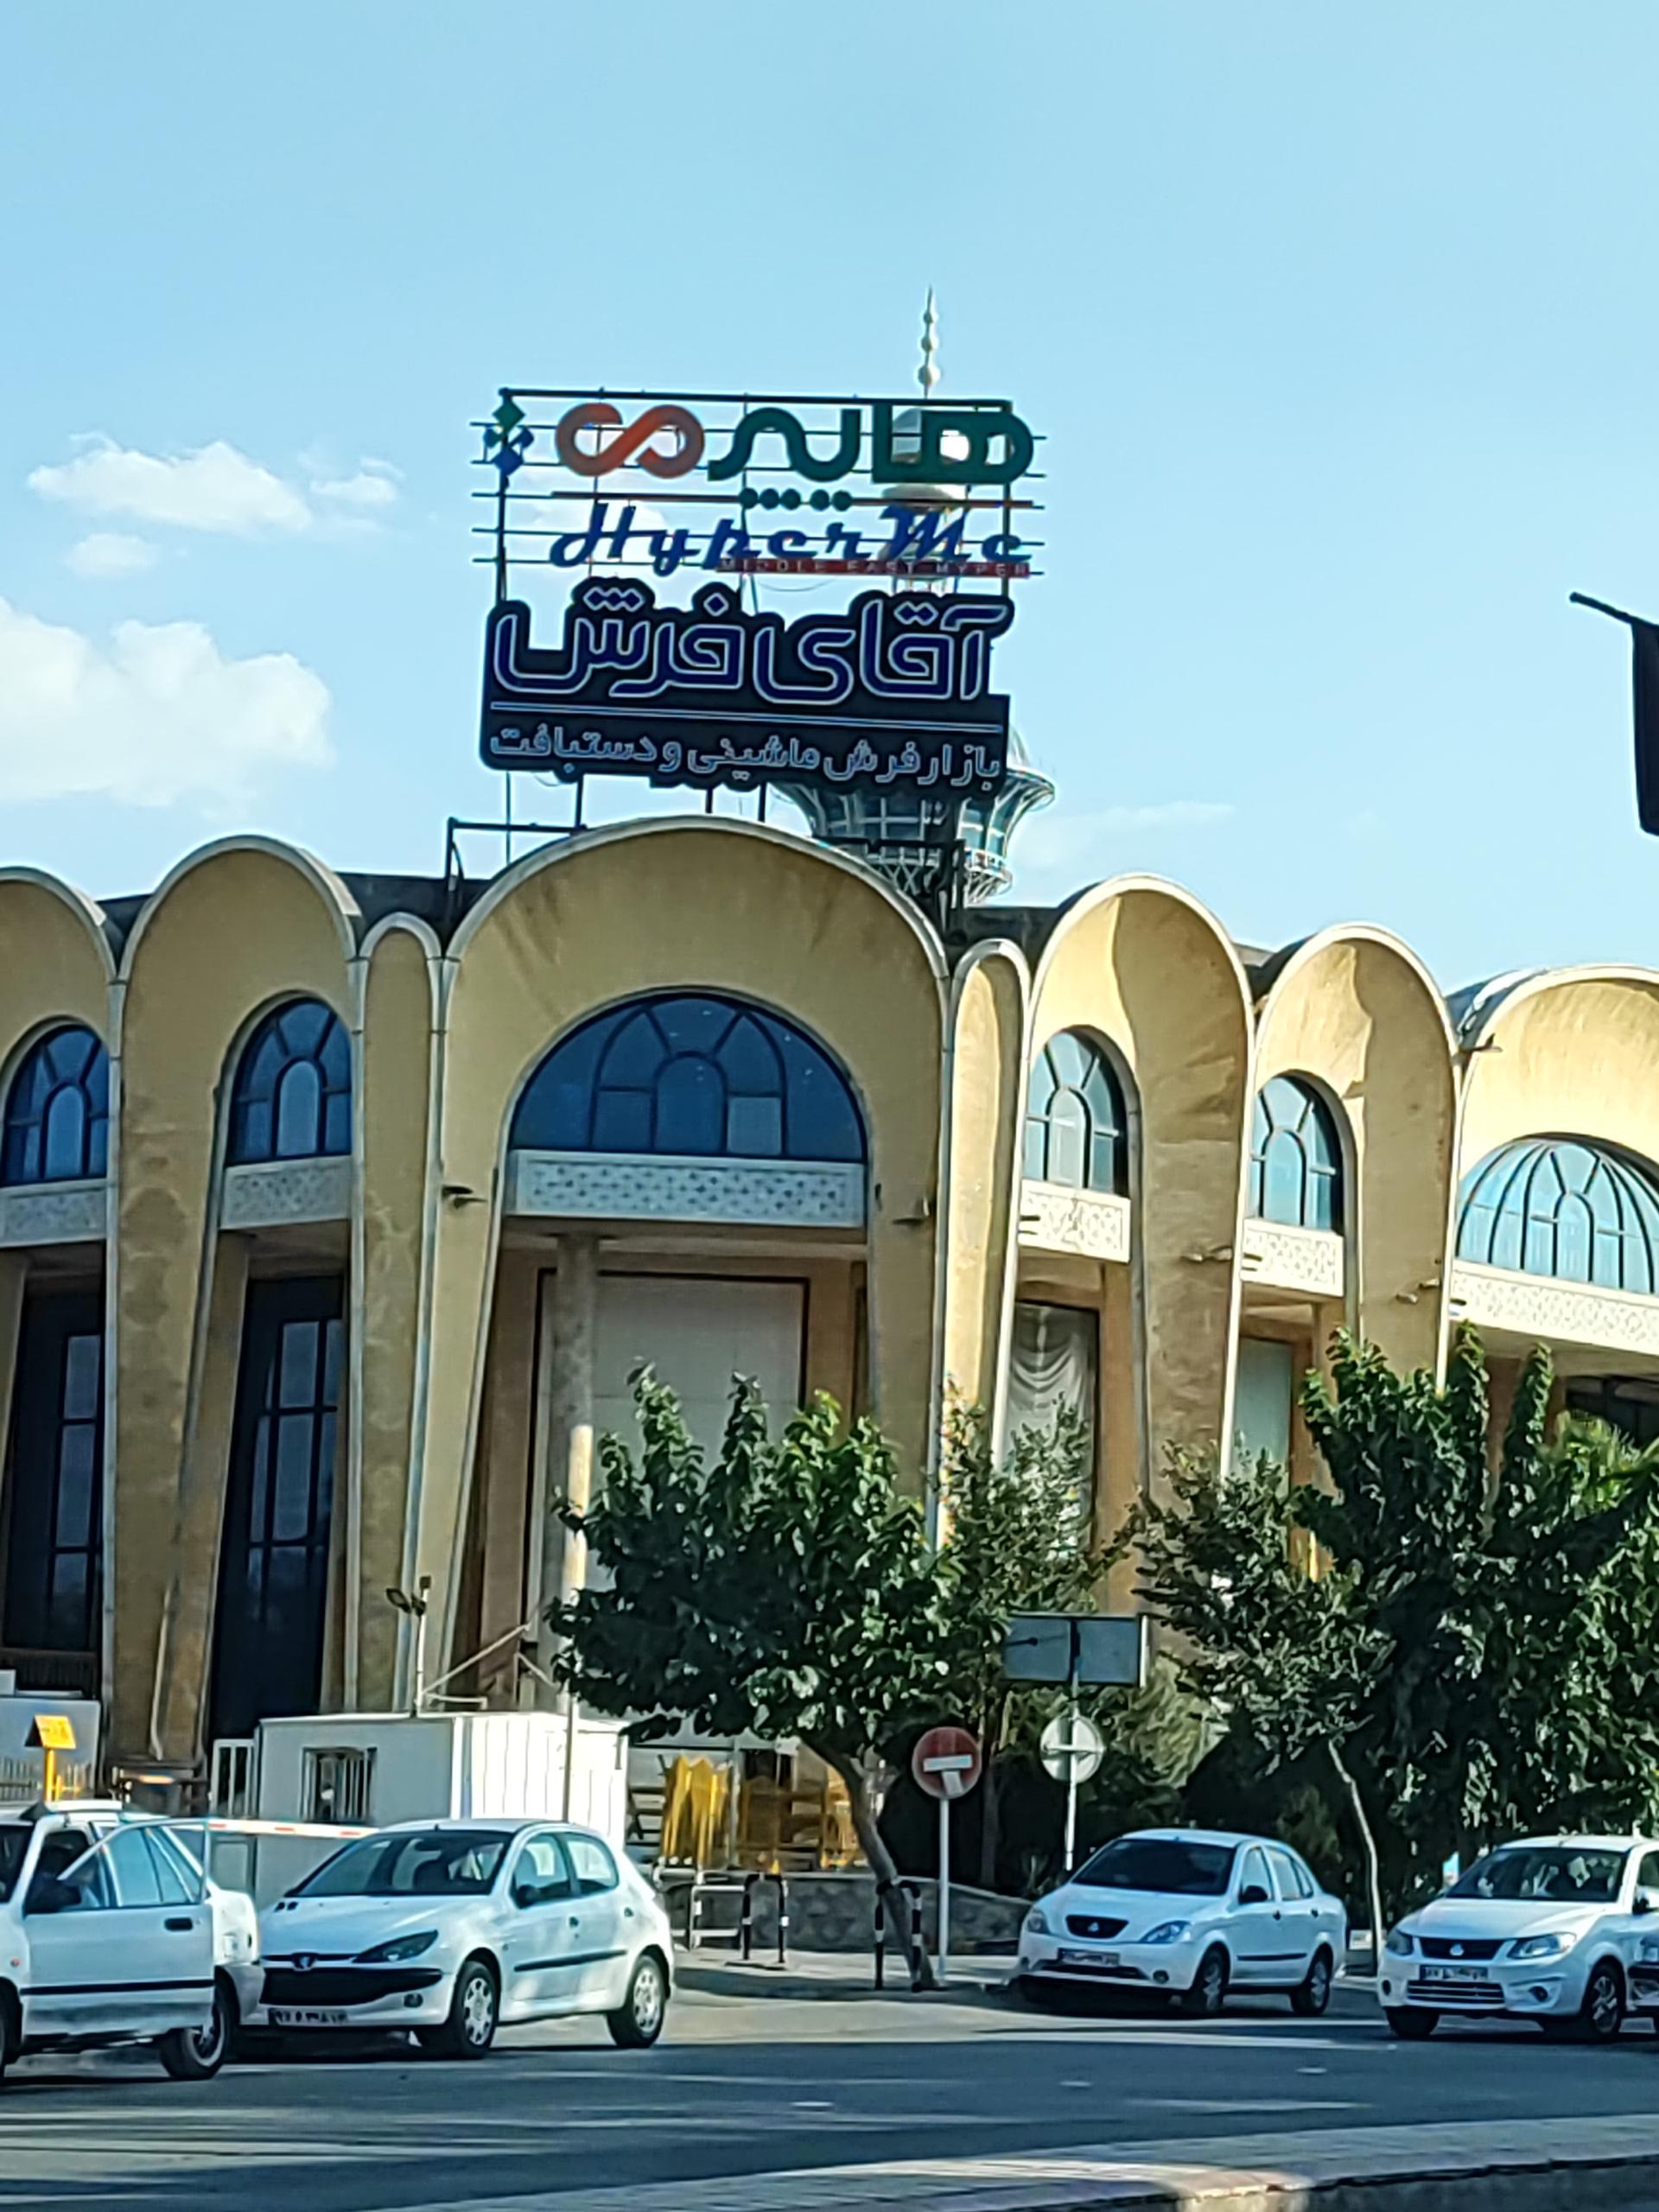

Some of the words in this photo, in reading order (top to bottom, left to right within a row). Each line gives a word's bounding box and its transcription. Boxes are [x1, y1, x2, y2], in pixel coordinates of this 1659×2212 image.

[493, 588, 747, 698] فرش
[753, 599, 1007, 706] آقای
[489, 722, 658, 774] دستبافت
[686, 734, 821, 782] ماشینی
[823, 738, 921, 784] فرش
[917, 743, 1001, 791] بازار
